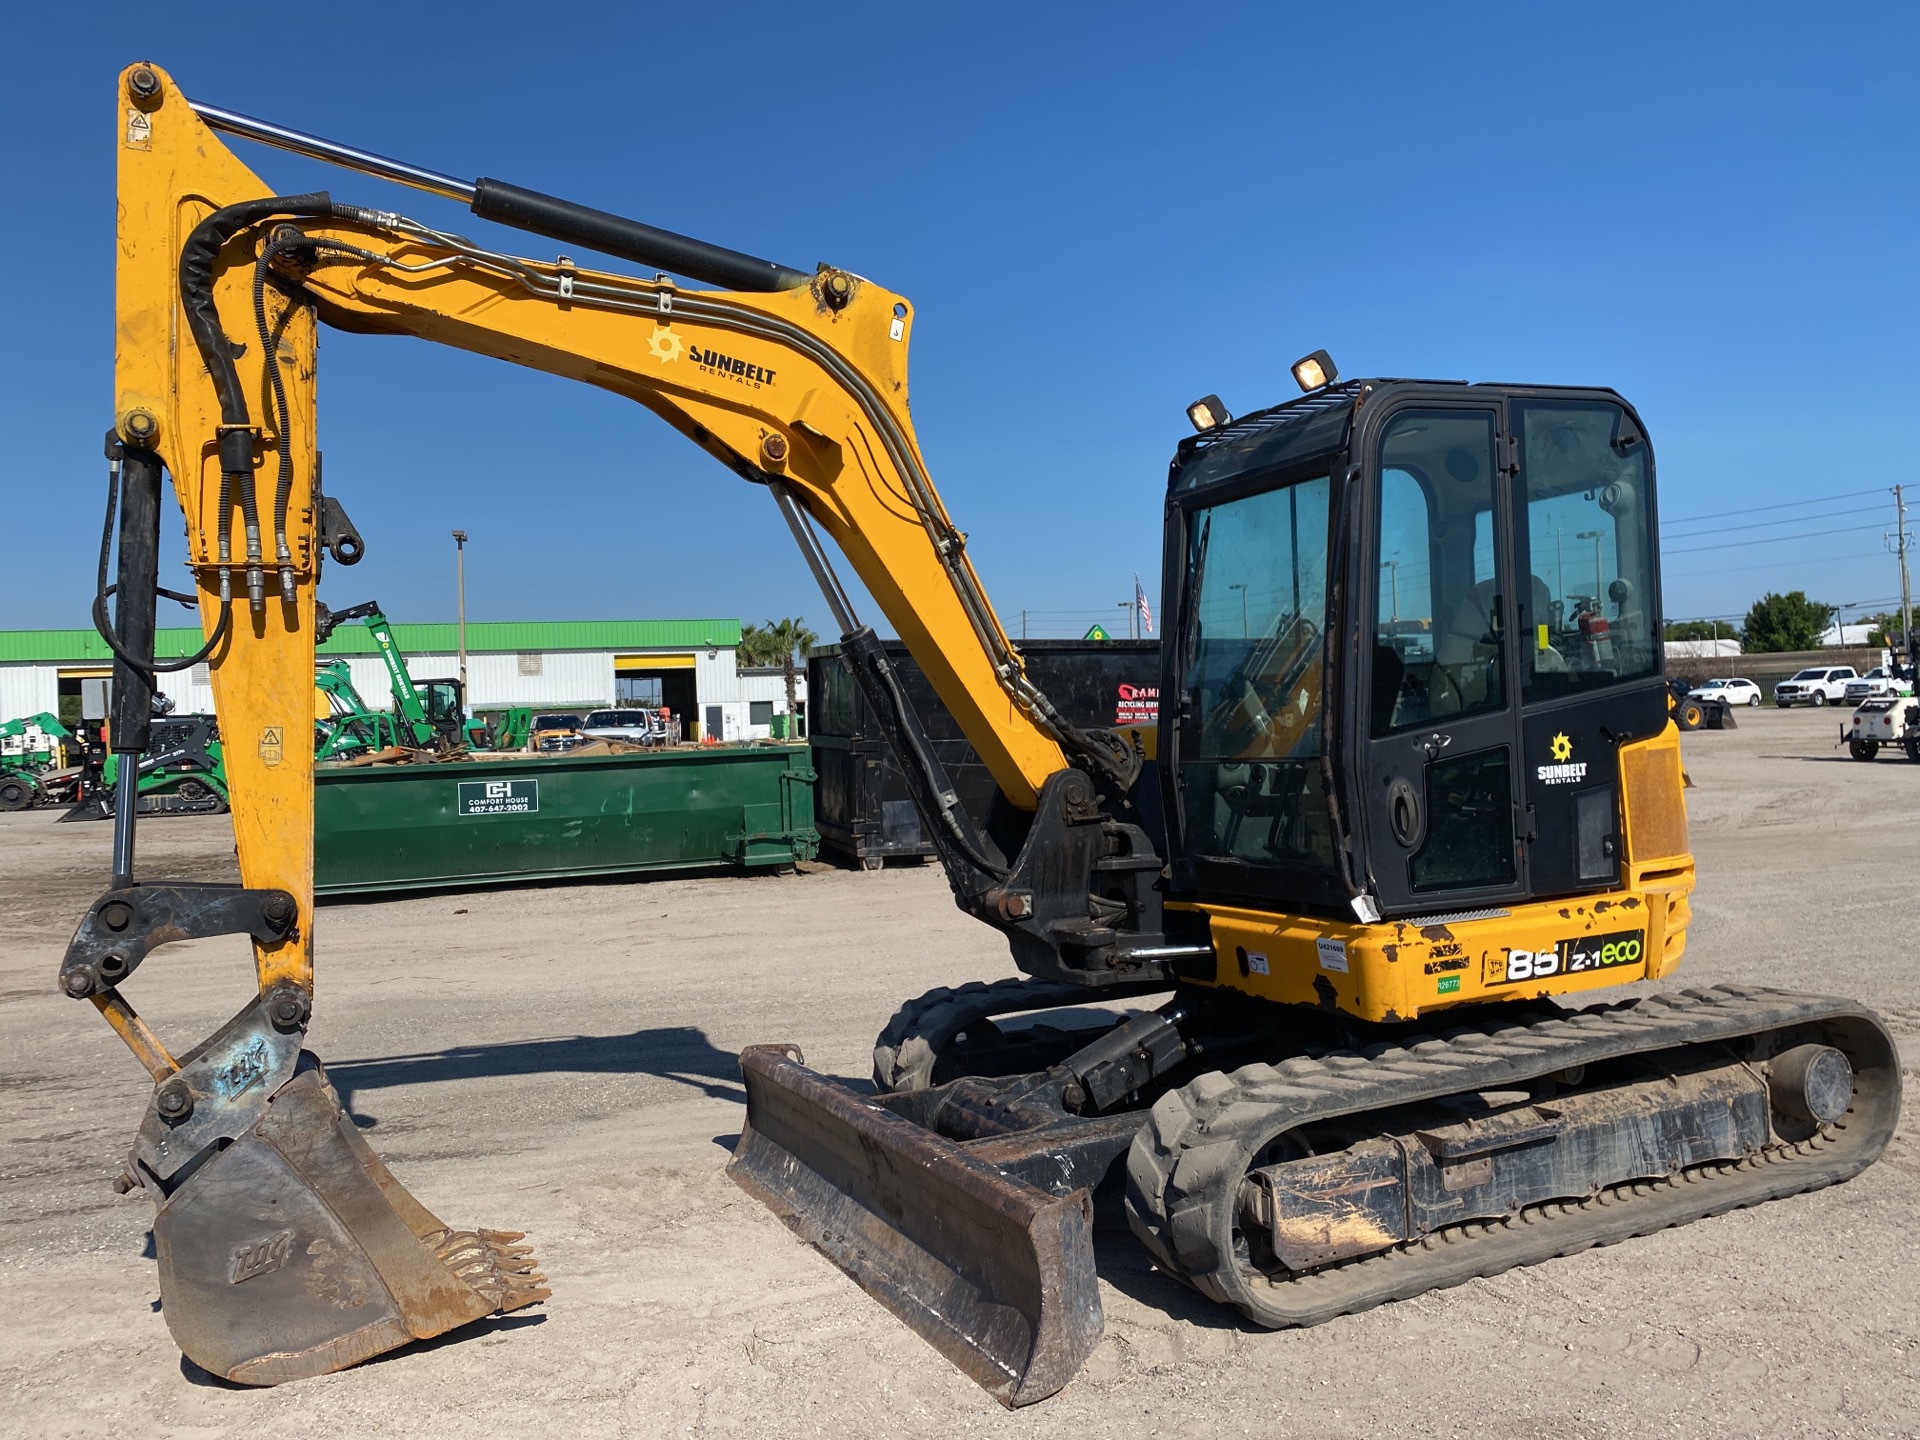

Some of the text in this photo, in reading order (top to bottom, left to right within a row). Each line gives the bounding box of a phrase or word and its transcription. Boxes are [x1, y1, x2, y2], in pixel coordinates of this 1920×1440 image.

[689, 345, 776, 385] SUNBELT
[699, 365, 761, 389] RENTALS
[385, 649, 411, 700] SUNBELT RENTALS
[1537, 763, 1587, 780] SUNBELT
[1545, 777, 1581, 785] RENTALS
[468, 798, 504, 806] COMFORT
[469, 804, 529, 813] 407-647-2002
[1508, 944, 1559, 980] 85
